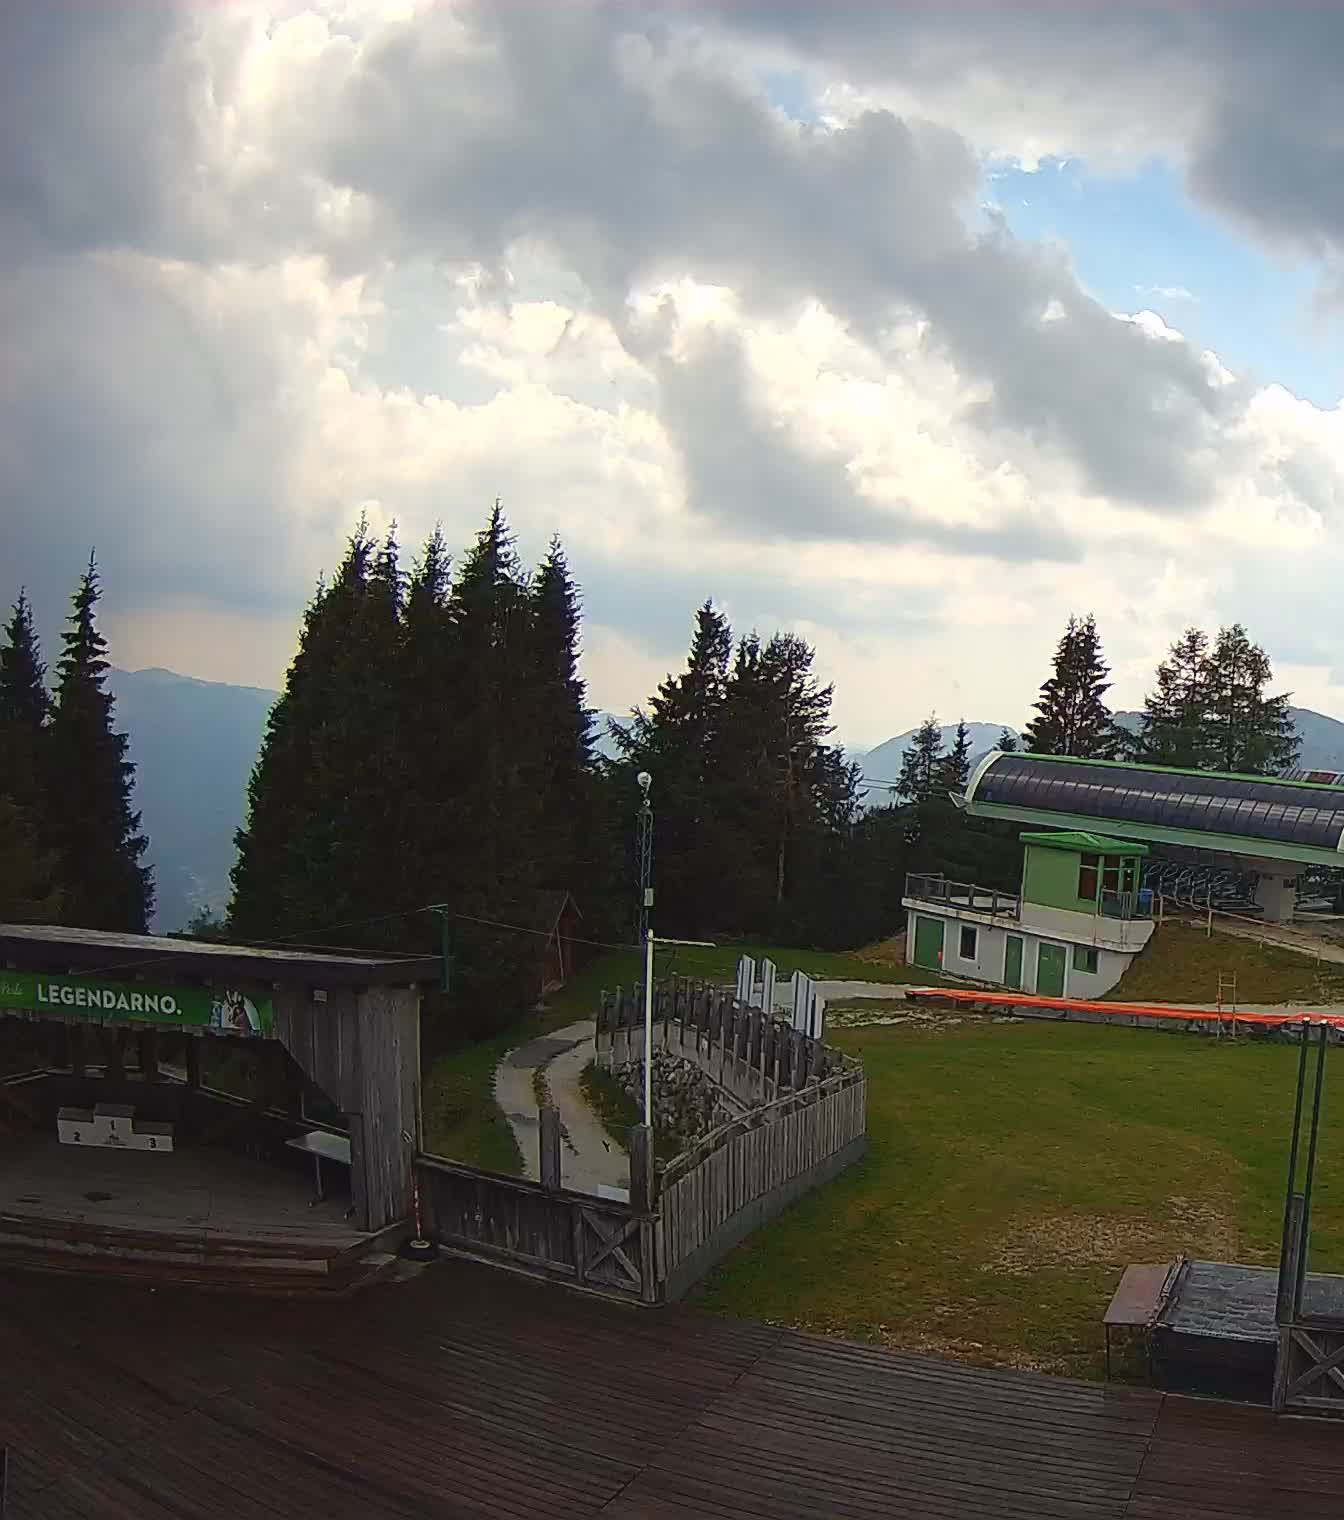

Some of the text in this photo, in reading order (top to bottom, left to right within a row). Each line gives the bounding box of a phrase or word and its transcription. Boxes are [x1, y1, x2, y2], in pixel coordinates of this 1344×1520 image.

[37, 983, 183, 1016] LEGENDARNO.
[110, 1120, 116, 1130] 1
[74, 1132, 81, 1142] 2
[149, 1138, 156, 1148] 3
